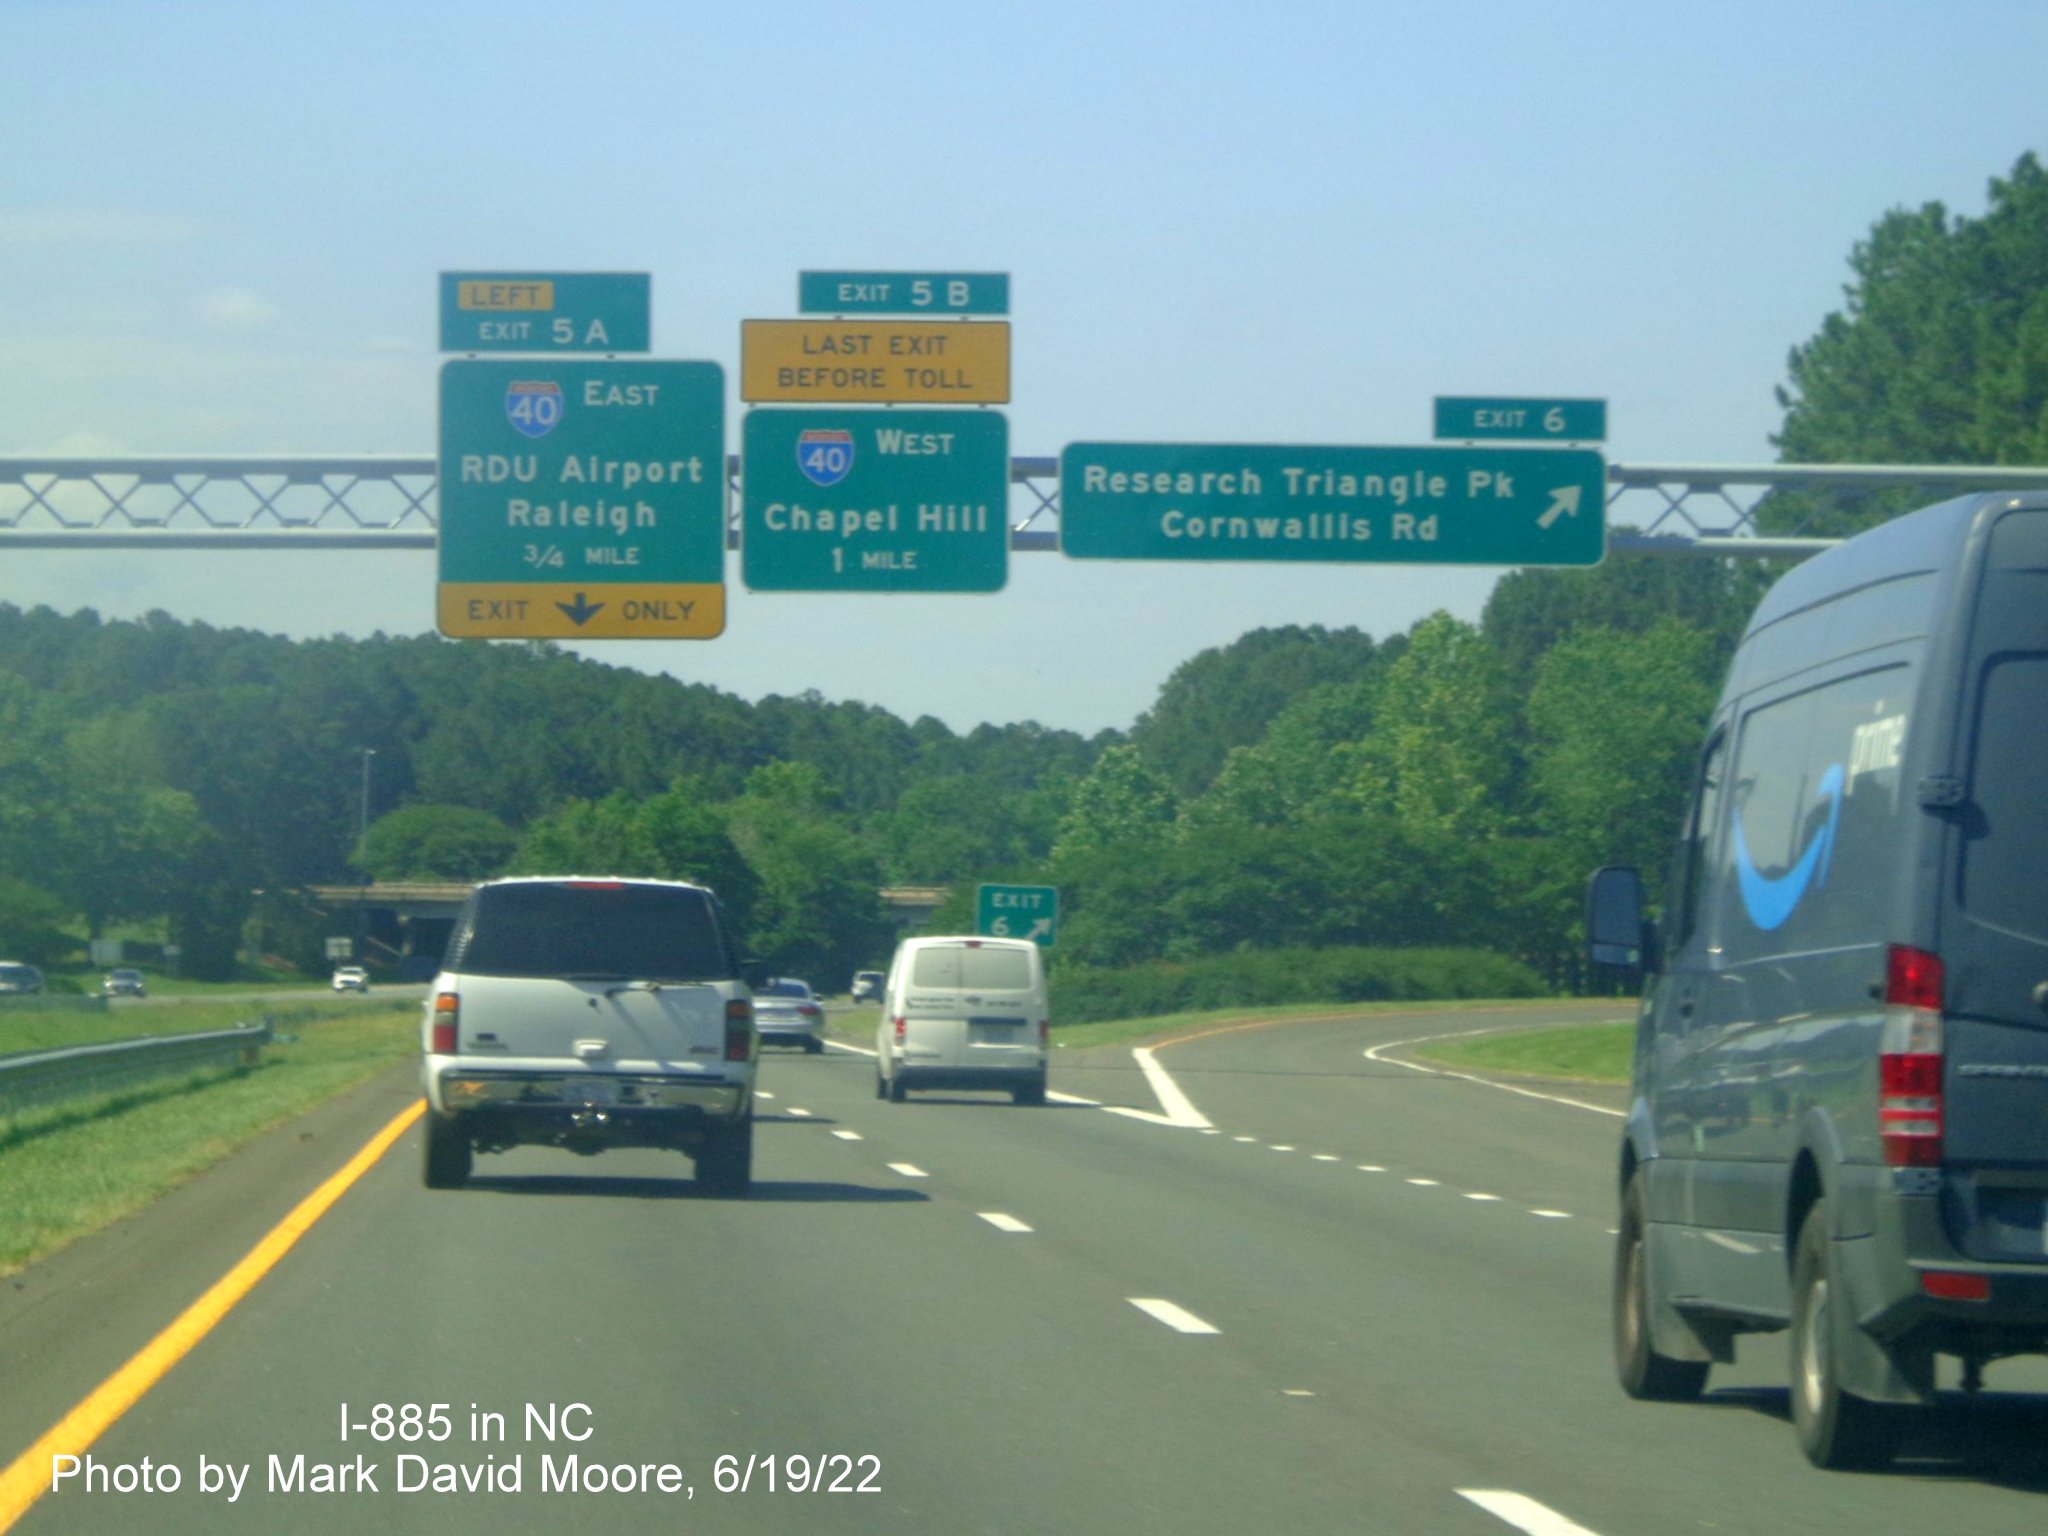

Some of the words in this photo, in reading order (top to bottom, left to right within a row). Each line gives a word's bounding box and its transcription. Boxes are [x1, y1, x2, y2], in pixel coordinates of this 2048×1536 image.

[471, 286, 540, 305] LEFT
[838, 284, 890, 301] EXIT
[912, 281, 932, 305] 5
[948, 281, 969, 306] B
[480, 323, 531, 339] EXIT
[553, 319, 573, 343] 5
[585, 319, 608, 344] A
[803, 336, 872, 355] LAST
[890, 336, 948, 355] EXIT
[778, 368, 885, 388] BEFORE
[904, 368, 973, 388] TOLL
[585, 380, 659, 406] EAST
[512, 396, 557, 425] 40
[1474, 410, 1525, 428] EXIT
[1543, 408, 1565, 432] 6
[876, 429, 954, 455] WEST
[462, 456, 537, 482] RDU
[561, 456, 703, 488] Airport
[806, 448, 845, 472] 40
[1084, 465, 1261, 495] Research
[1283, 468, 1446, 506] Triangle
[1468, 470, 1515, 498] Pk
[508, 500, 656, 534] Raleigh
[765, 504, 897, 537] Chapel
[918, 504, 986, 531] Hill
[1161, 510, 1371, 540] Cornwallis
[1392, 513, 1438, 541] Rd
[524, 545, 564, 568] 3/4
[585, 548, 639, 564] MILE
[832, 548, 843, 572] 1
[862, 551, 917, 569] MILE
[468, 601, 527, 620] EXIT
[623, 601, 694, 620] ONLY
[993, 894, 1041, 907] EXIT
[992, 918, 1008, 936] 6
